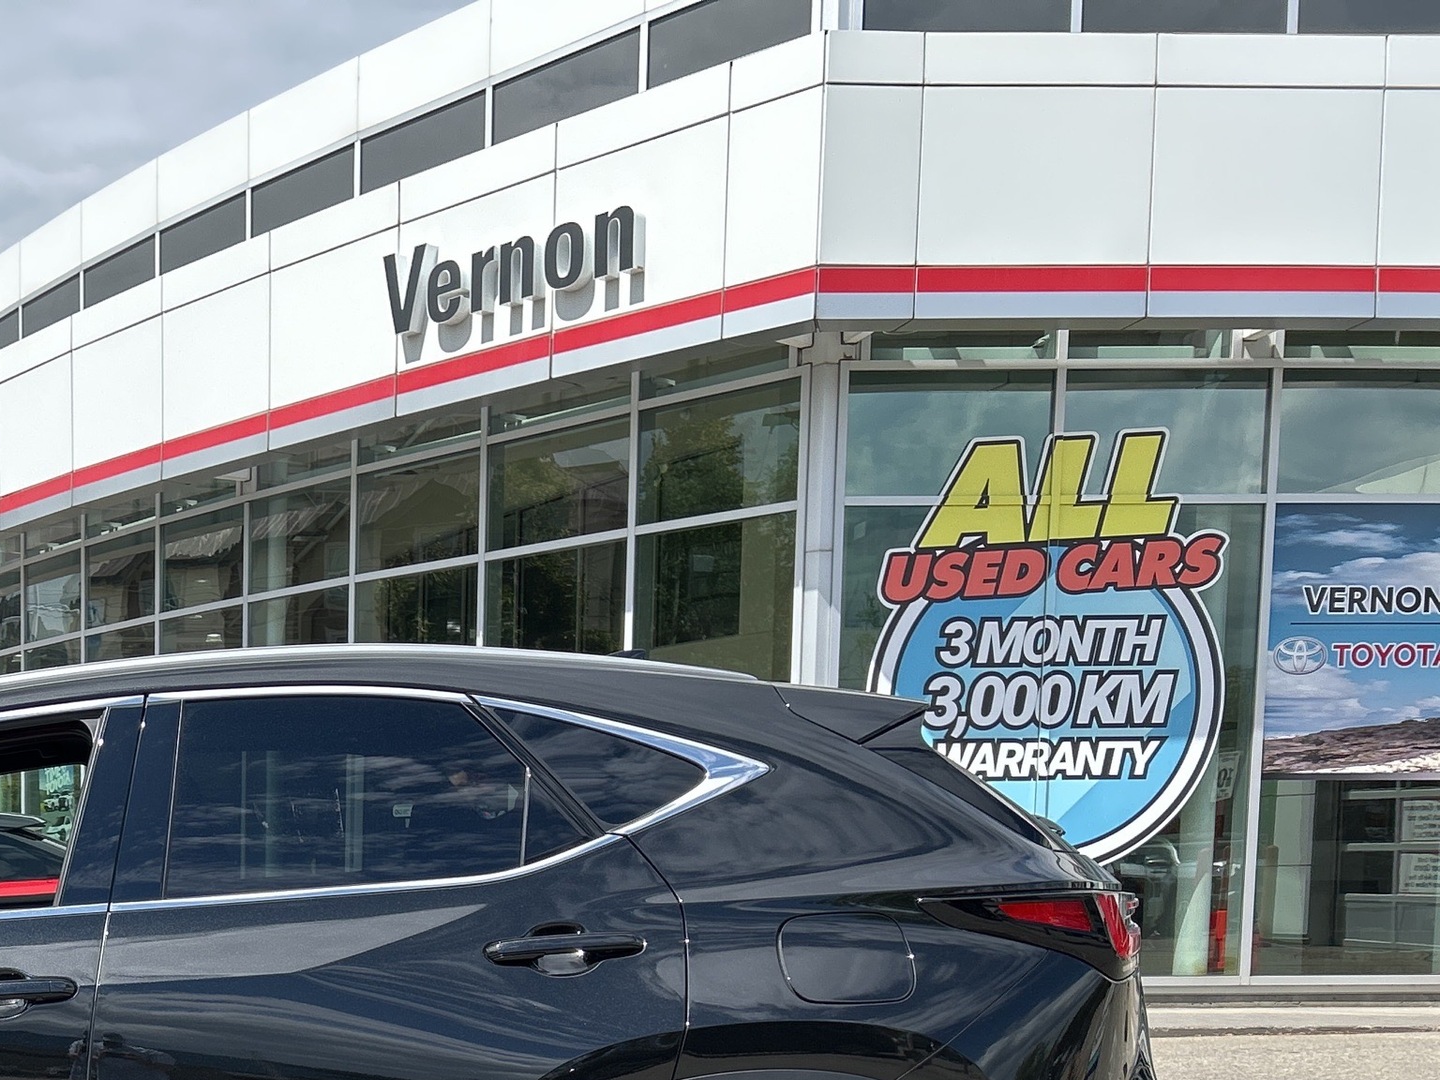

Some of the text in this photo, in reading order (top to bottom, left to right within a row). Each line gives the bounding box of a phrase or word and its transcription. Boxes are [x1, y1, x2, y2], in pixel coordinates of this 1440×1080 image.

[383, 205, 638, 335] Vernon
[916, 431, 1179, 549] ALL
[883, 536, 1225, 600] USED CARS
[936, 615, 1165, 667] 3 MONTH
[925, 671, 1177, 738] 3,000 KM
